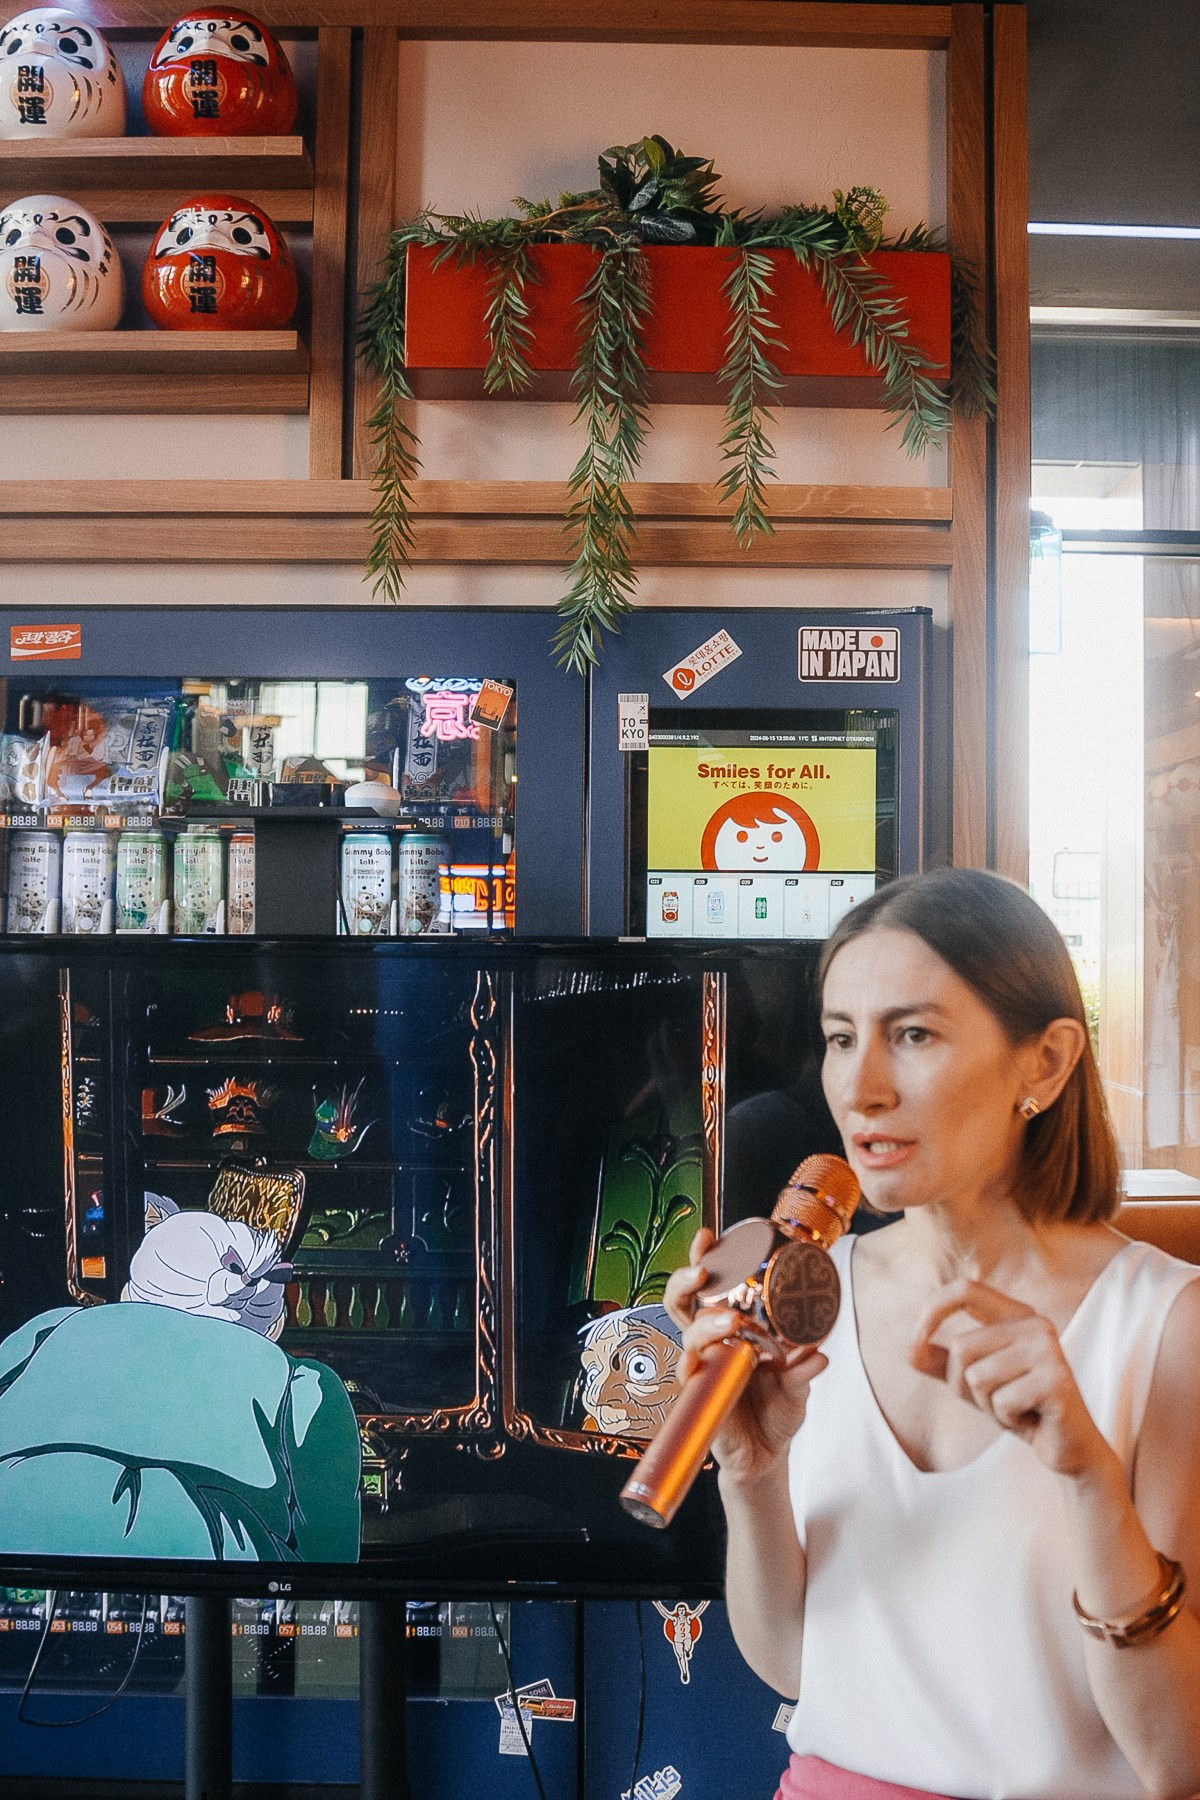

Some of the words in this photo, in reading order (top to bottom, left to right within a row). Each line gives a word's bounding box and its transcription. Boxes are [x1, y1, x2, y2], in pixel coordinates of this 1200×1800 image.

[17, 65, 47, 125] 開運
[14, 256, 44, 315] 開運
[802, 630, 857, 650] MADE
[695, 643, 733, 677] LOTTE
[802, 651, 824, 677] IN
[828, 651, 895, 677] JAPAN
[483, 680, 512, 697] TOKYO
[621, 718, 636, 728] TO
[621, 729, 645, 739] KYO
[697, 763, 760, 778] Smiles
[767, 764, 795, 778] for
[799, 765, 831, 779] All.
[47, 817, 63, 826] 003
[454, 818, 470, 827] 010
[280, 1583, 292, 1591] LG
[16, 1620, 40, 1630] 88.88
[72, 1621, 97, 1632] 88.88
[107, 1622, 122, 1631] 054
[164, 1623, 179, 1633] 055
[244, 1625, 269, 1634] 88.88
[279, 1626, 293, 1634] 057
[301, 1625, 327, 1635] 88.88
